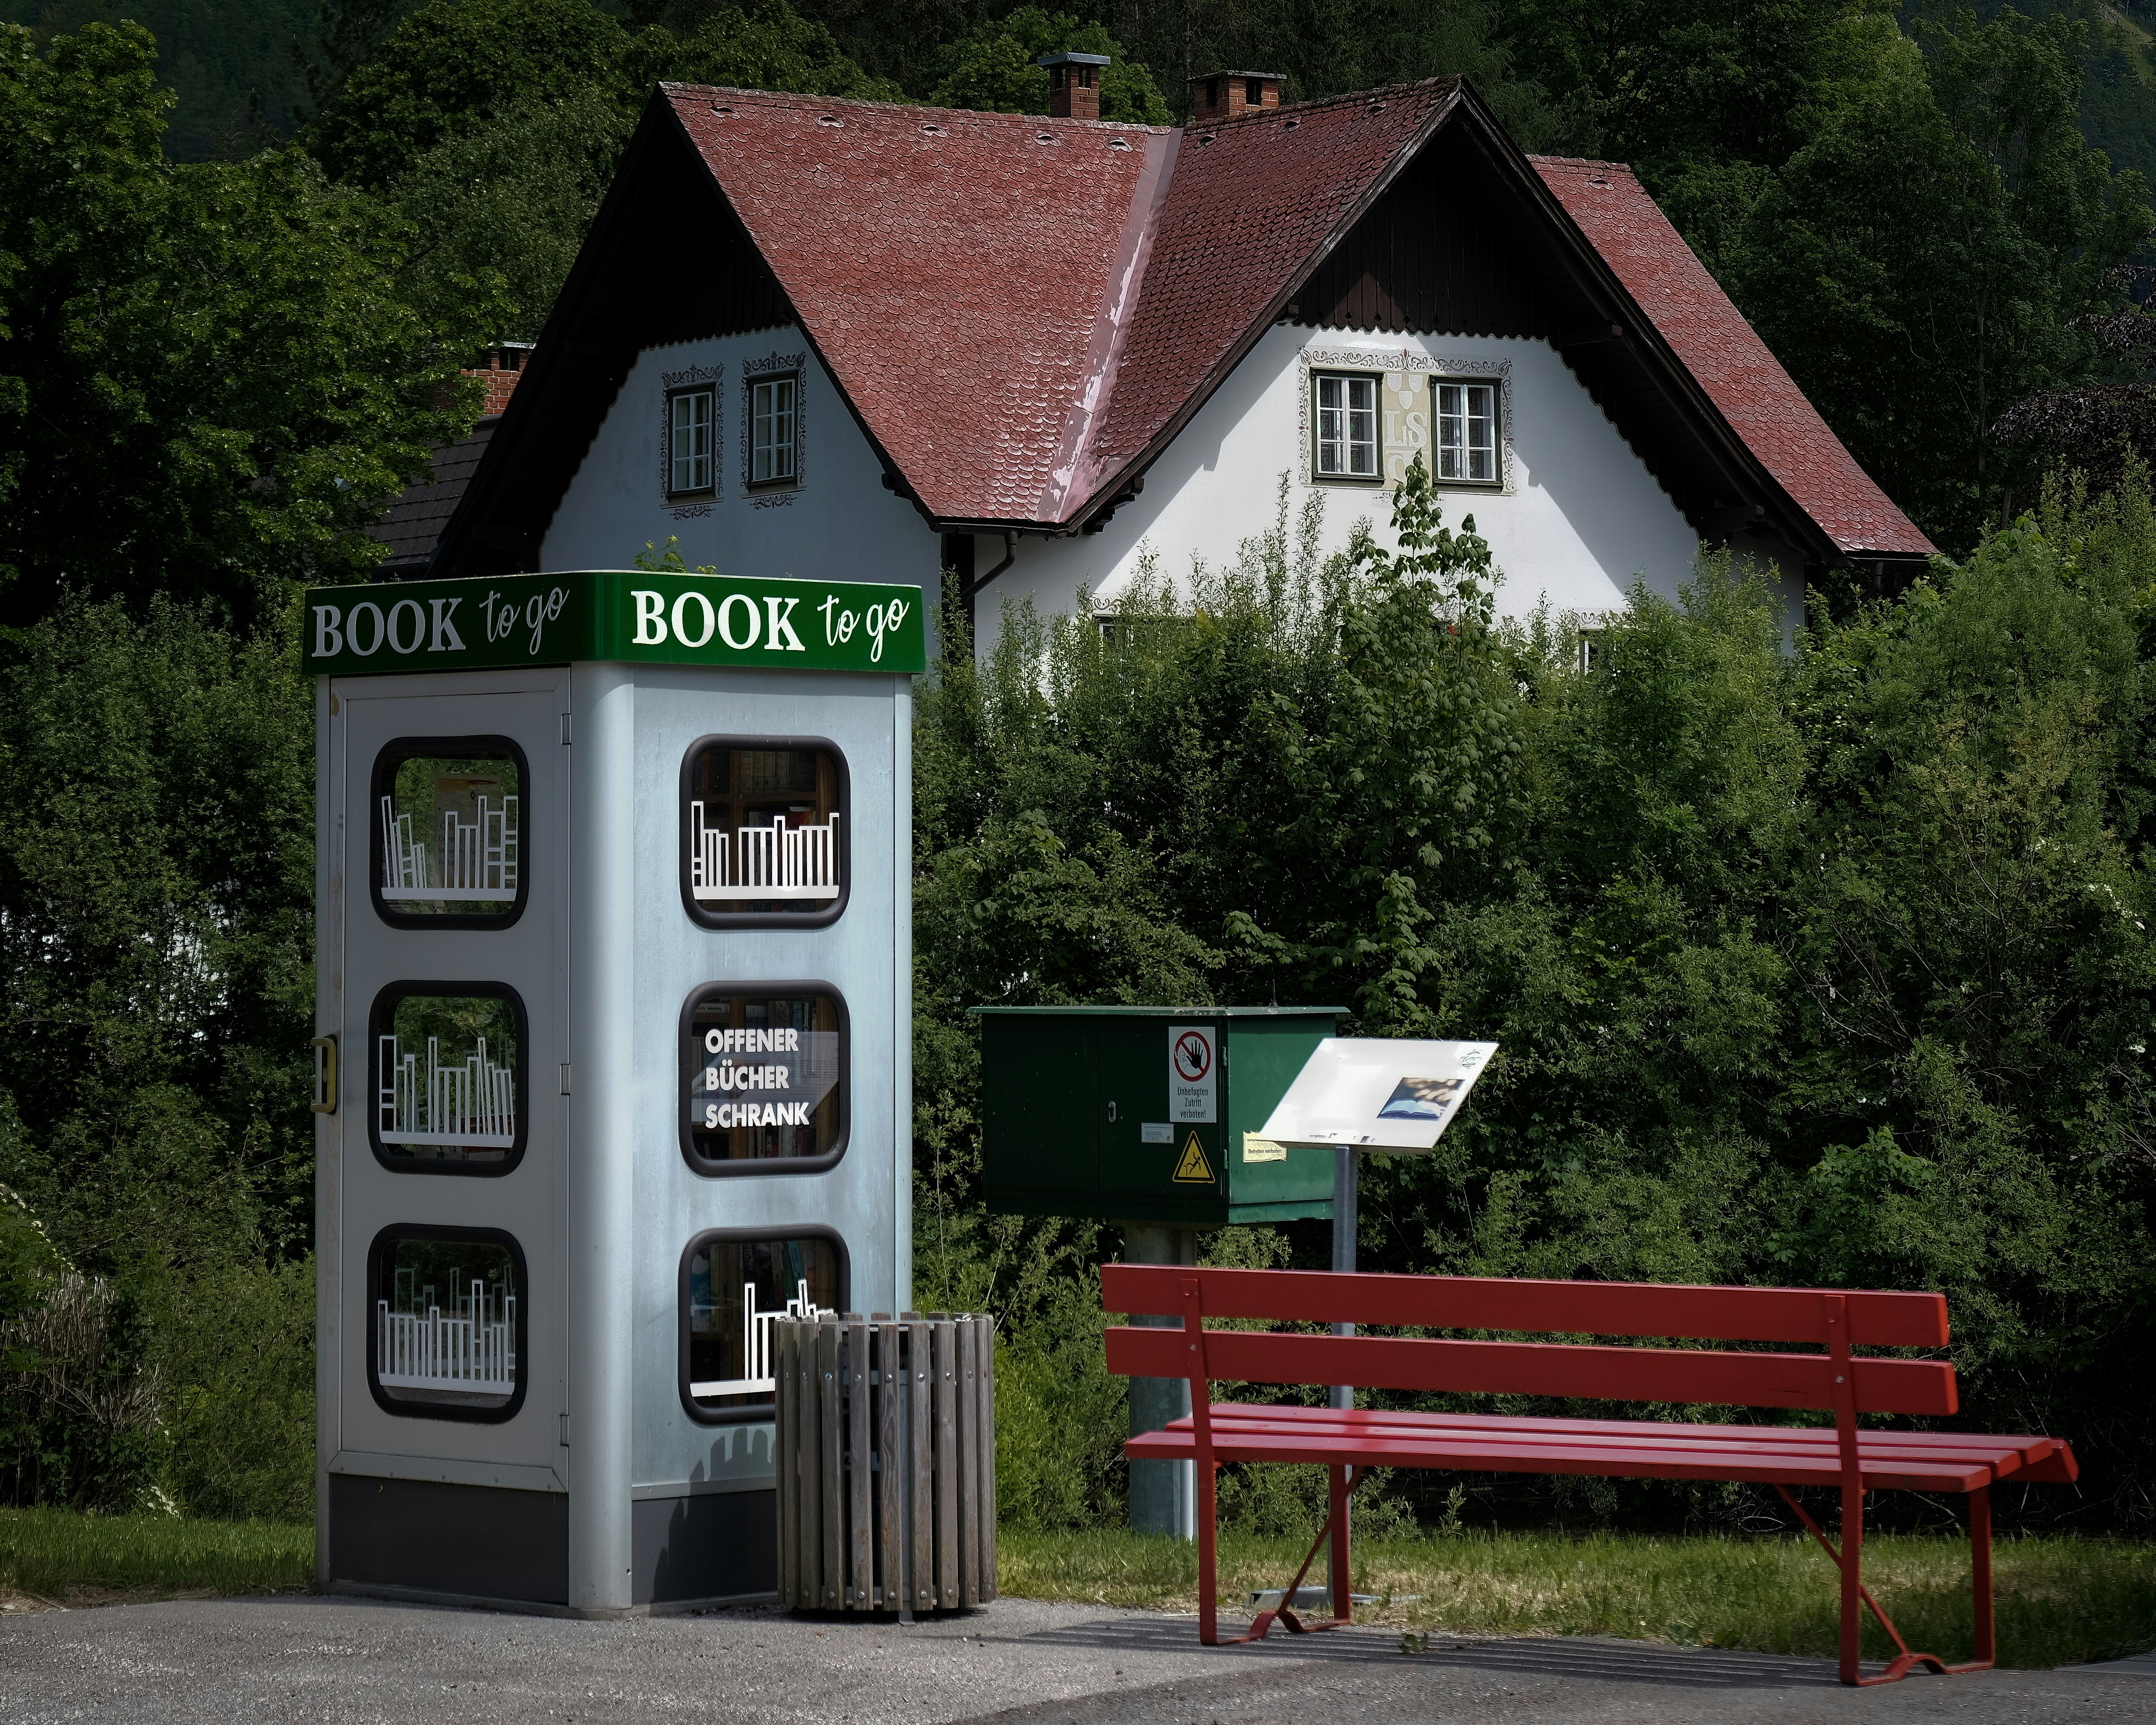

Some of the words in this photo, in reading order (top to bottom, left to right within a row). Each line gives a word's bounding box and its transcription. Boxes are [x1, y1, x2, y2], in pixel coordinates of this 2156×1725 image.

[312, 597, 466, 658] BOOK
[479, 590, 521, 643] to
[526, 587, 570, 655] go
[630, 590, 806, 651] BOOK
[817, 594, 861, 647] to
[866, 598, 910, 663] go
[705, 1028, 799, 1054] OFFENER
[706, 1059, 789, 1090] BÜCHER
[1178, 1087, 1208, 1098] Unbefugten
[1185, 1098, 1202, 1107] Zutritt
[705, 1102, 810, 1129] SCHRANK
[1180, 1109, 1206, 1118] verboten!
